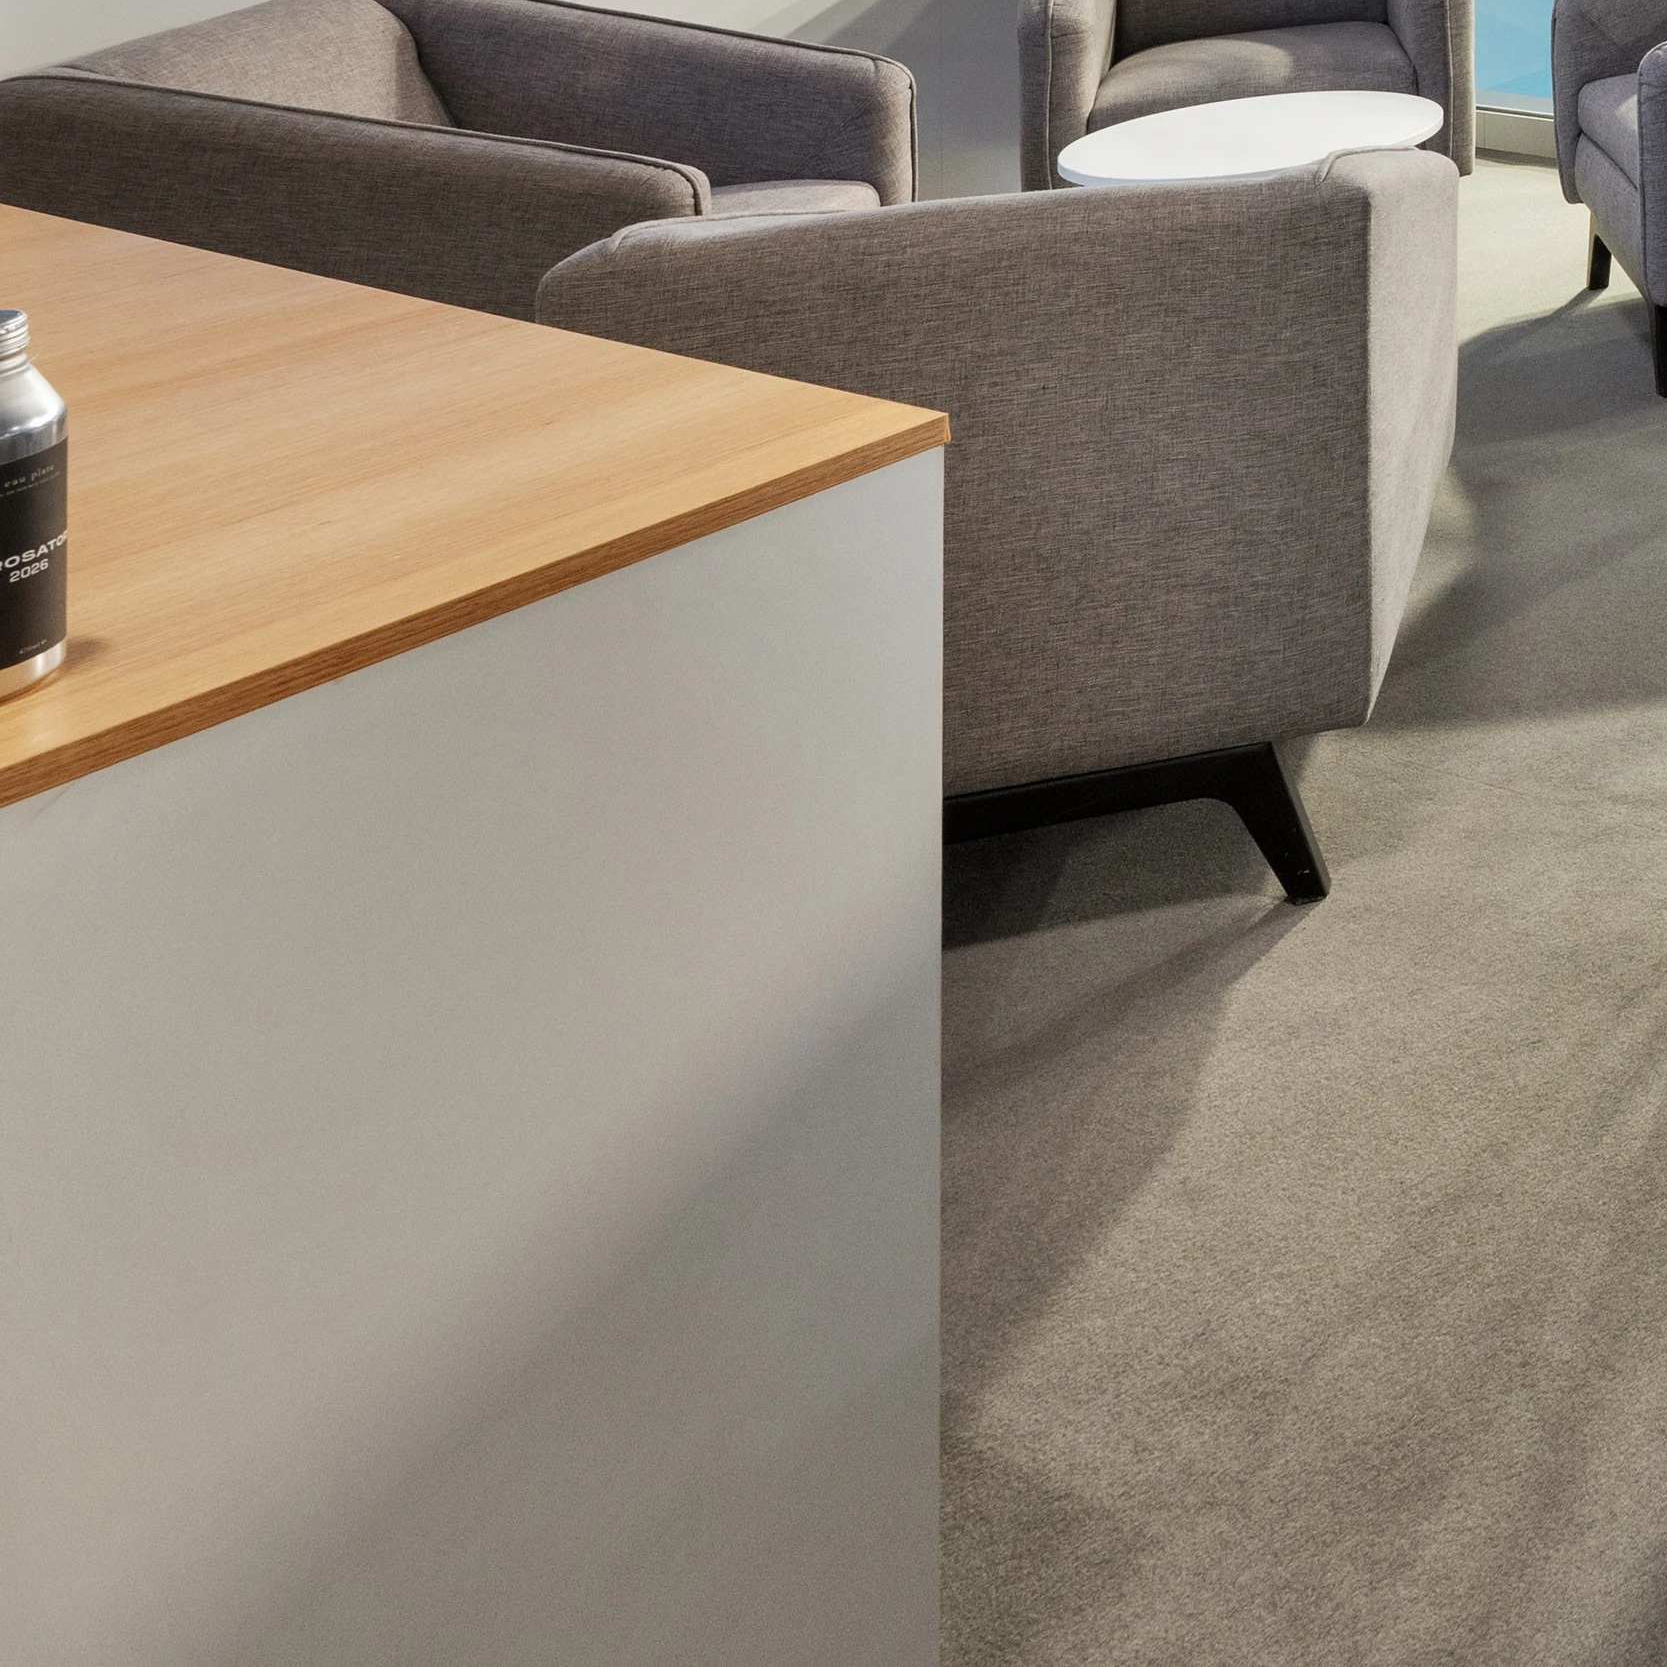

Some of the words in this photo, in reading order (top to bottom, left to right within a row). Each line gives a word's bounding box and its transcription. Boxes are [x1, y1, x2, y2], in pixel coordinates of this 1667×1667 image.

[4, 475, 26, 488] eau
[31, 465, 55, 482] plate
[9, 558, 49, 583] 2026
